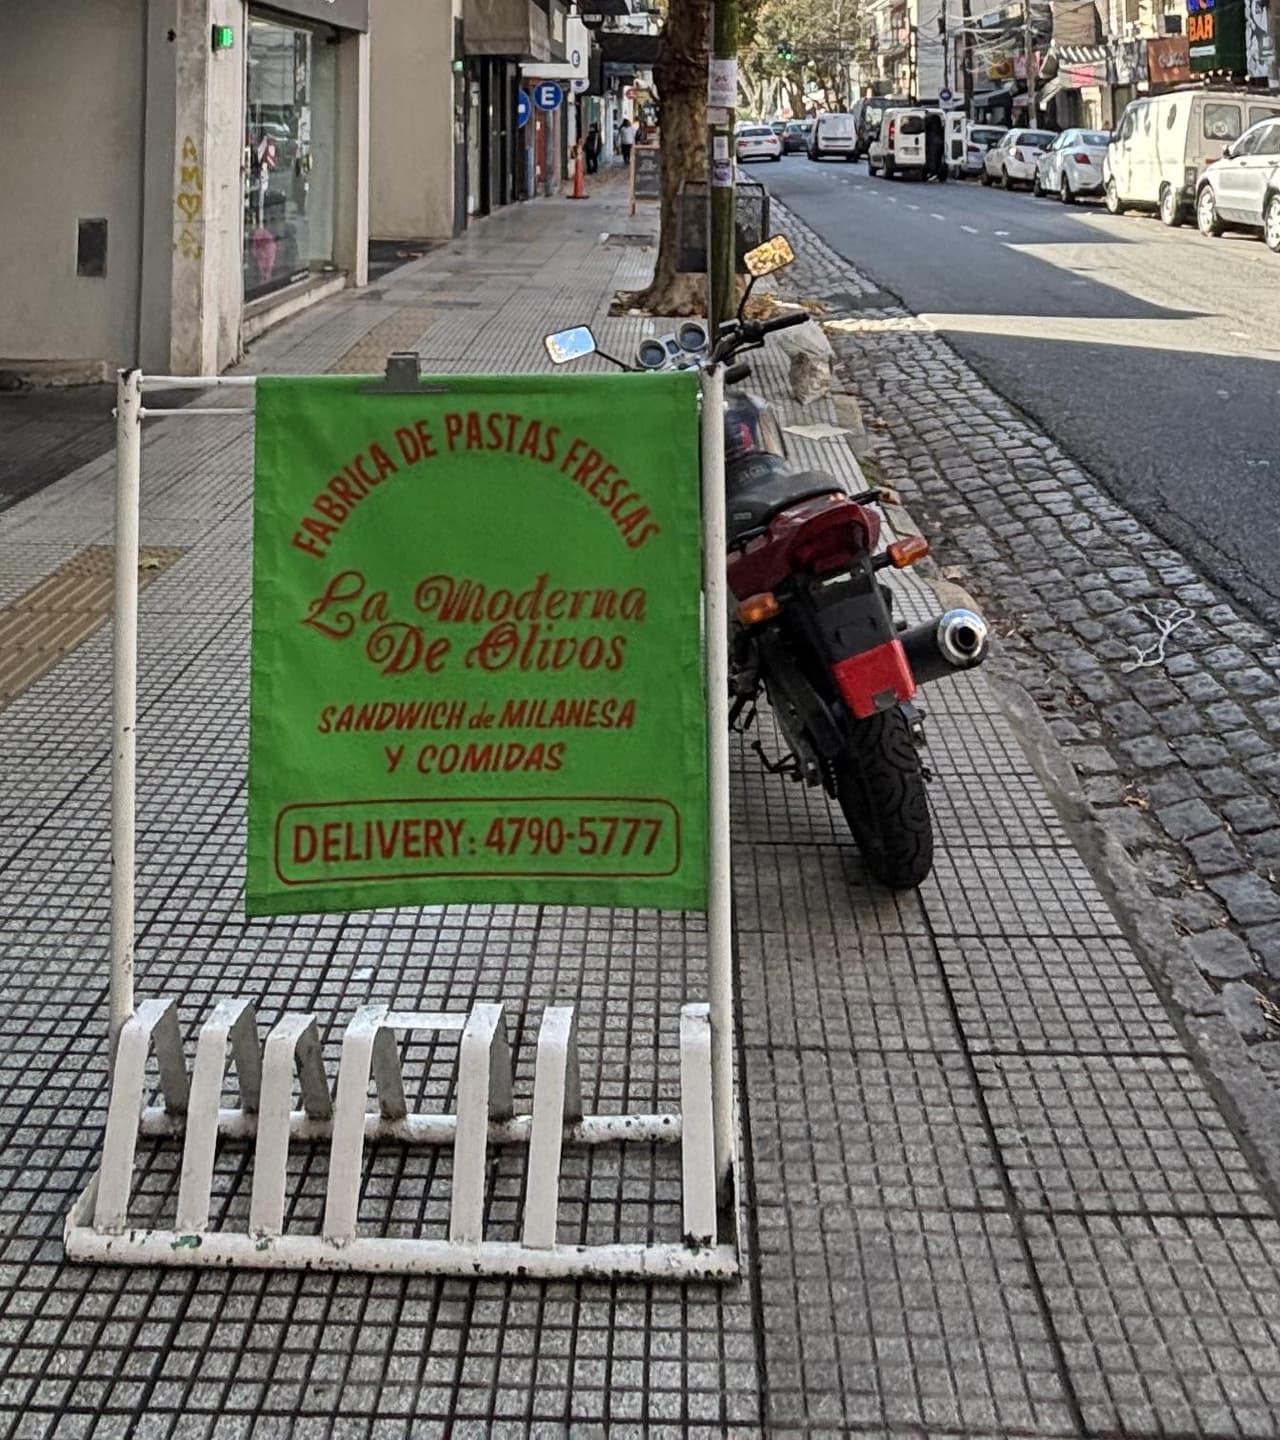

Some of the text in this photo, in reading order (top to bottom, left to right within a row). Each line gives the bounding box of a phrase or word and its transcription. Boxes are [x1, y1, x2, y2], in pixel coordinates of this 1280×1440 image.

[1189, 14, 1213, 42] BAR
[541, 86, 555, 106] E
[291, 410, 661, 560] FABRICA DE PASTAS FRESCAS
[302, 570, 647, 640] La Moderna
[366, 621, 628, 676] De Olivos
[318, 698, 637, 734] SANDWICH de MILANESA
[385, 742, 566, 775] Y COMIDAS
[484, 817, 664, 858] 4790-5777
